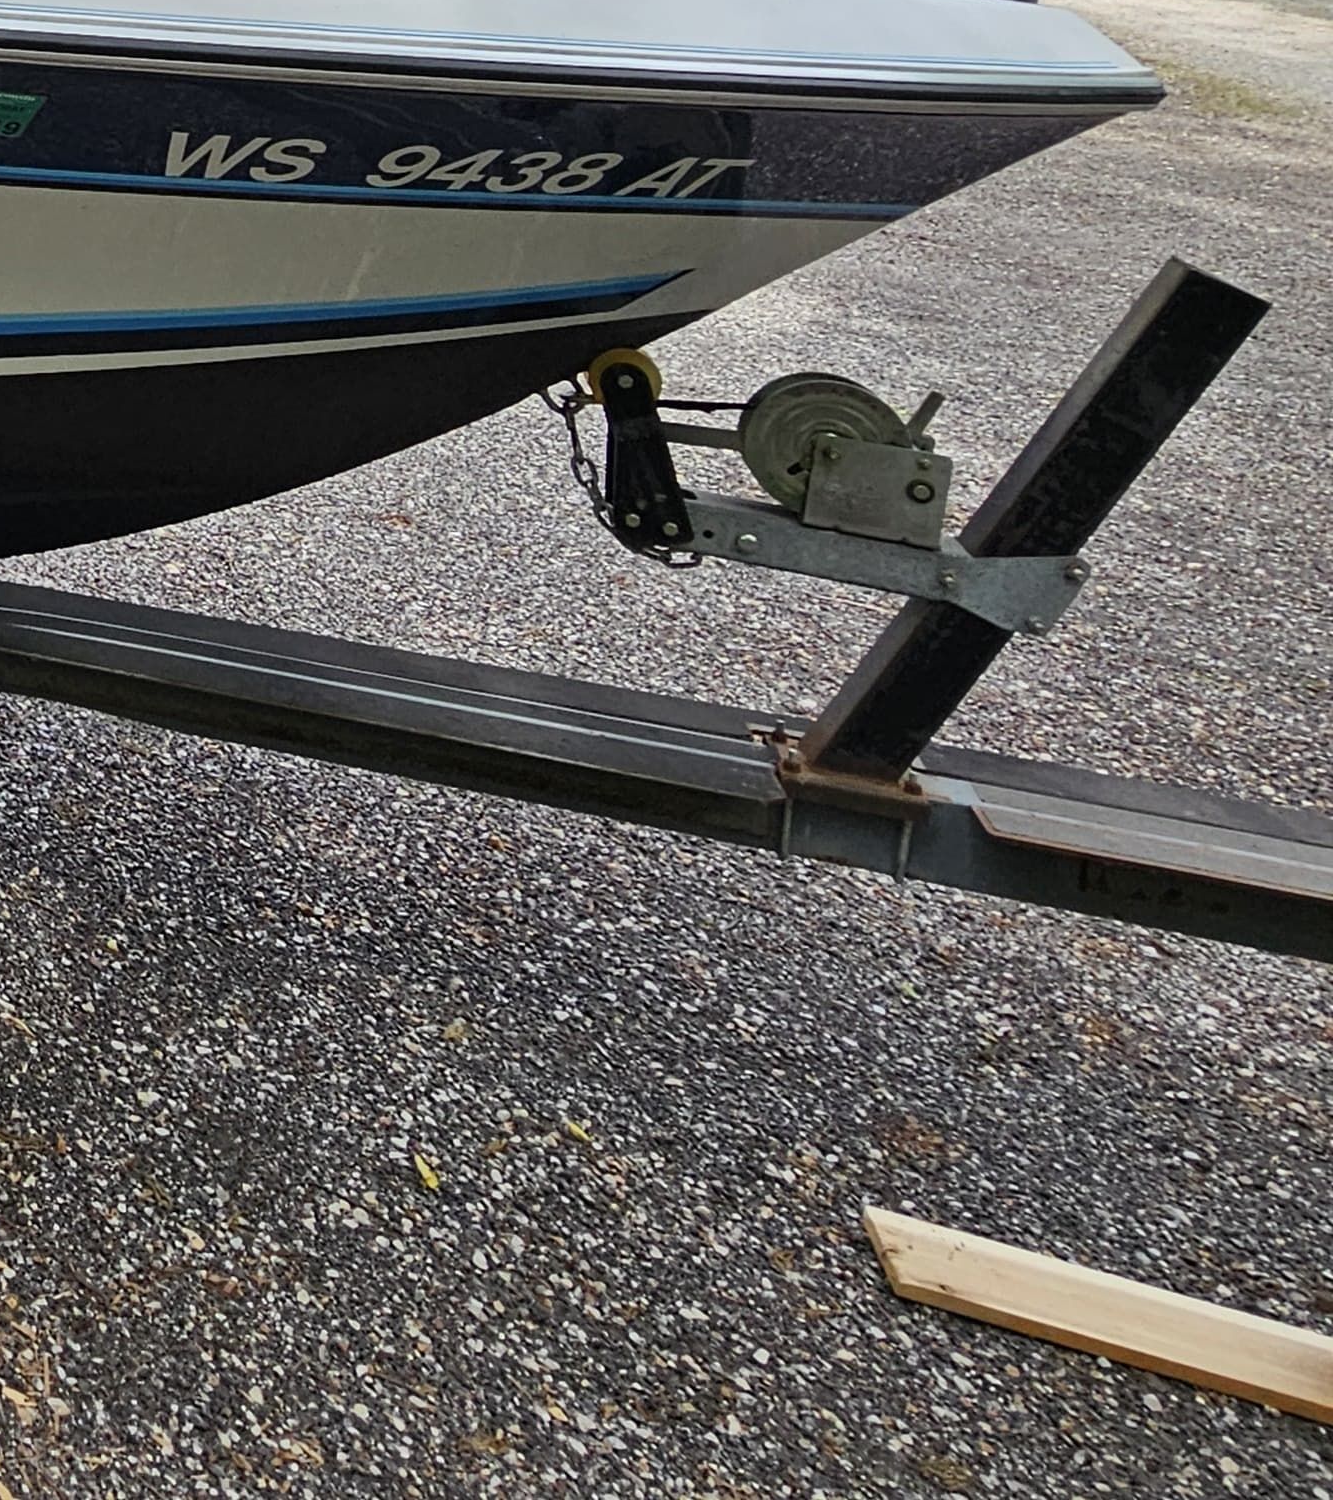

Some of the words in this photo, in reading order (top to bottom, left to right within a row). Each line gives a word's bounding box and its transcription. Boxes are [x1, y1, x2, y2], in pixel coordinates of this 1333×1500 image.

[164, 131, 327, 182] WS
[365, 144, 625, 195] 9438
[613, 156, 756, 198] AT
